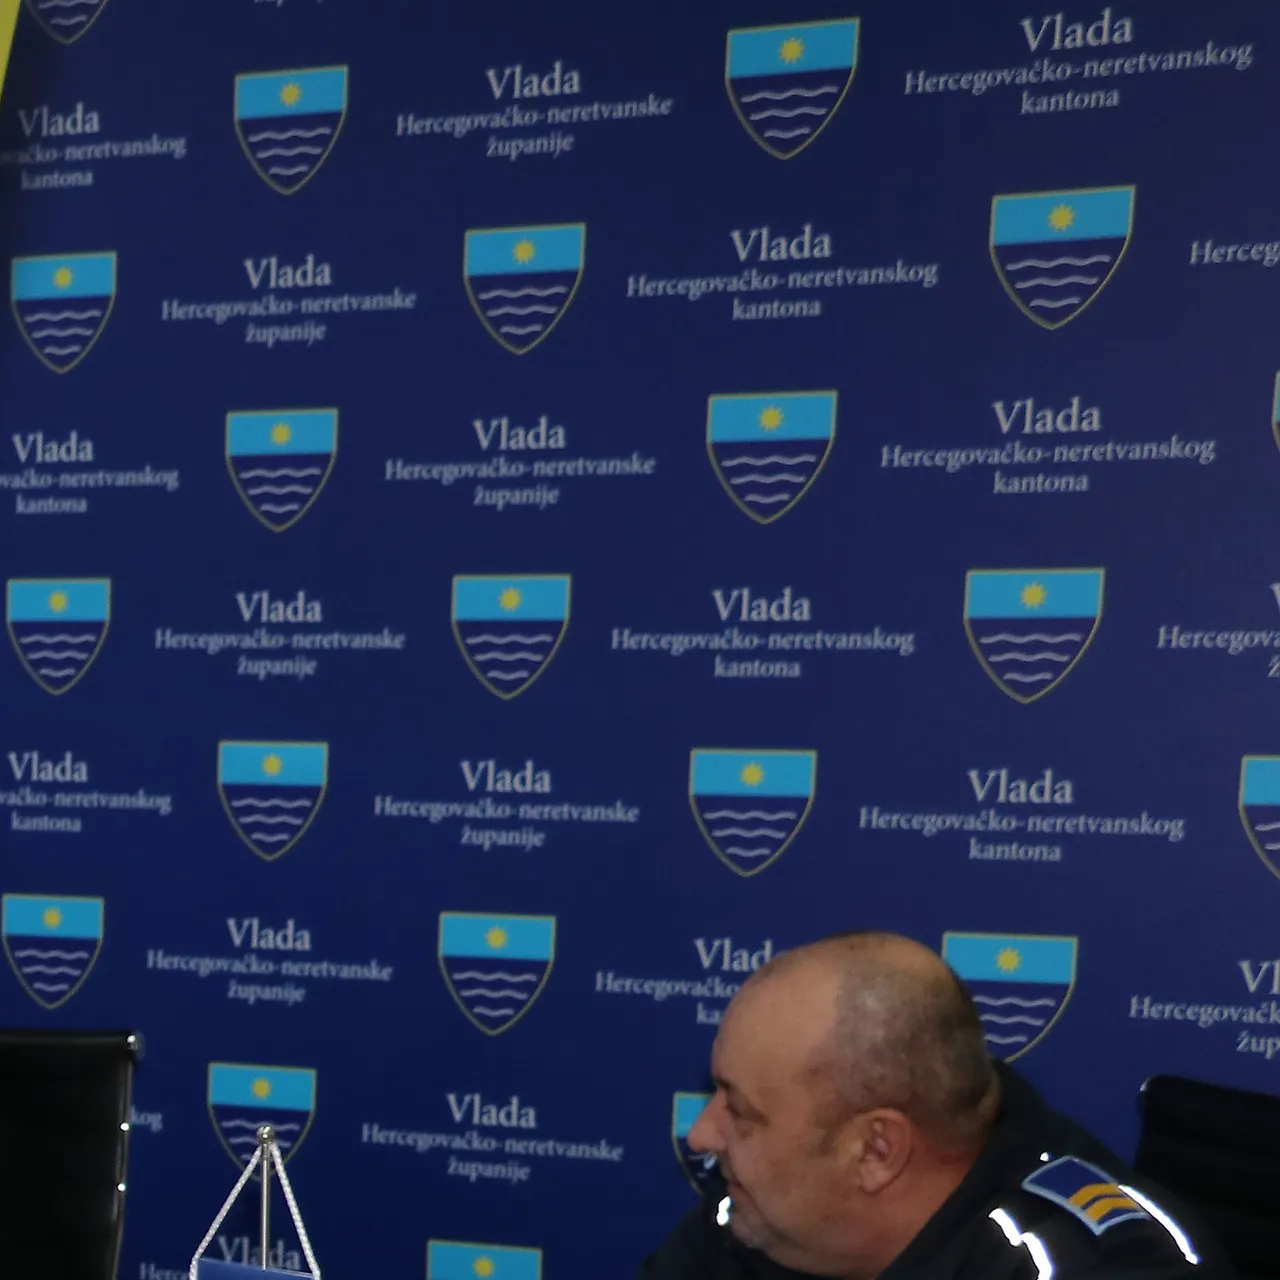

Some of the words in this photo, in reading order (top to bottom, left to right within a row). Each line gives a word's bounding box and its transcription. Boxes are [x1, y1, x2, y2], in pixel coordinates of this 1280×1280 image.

[1020, 6, 1133, 53] Vlada
[485, 60, 581, 100] Vlada
[904, 40, 1253, 96] Hercegovačko-neretvanskog
[395, 93, 673, 138] Hercegovačko-neretvanske
[1020, 88, 1120, 115] kantona
[17, 101, 100, 138] Vlada
[486, 131, 576, 162] županije
[21, 169, 94, 191] kantona
[730, 222, 832, 263] Vlada
[243, 253, 333, 290] Vlada
[626, 259, 939, 302] Hercegovačko-neretvanskog
[161, 286, 417, 325] Hercegovačko-neretvanske
[731, 297, 821, 321] kantona
[244, 321, 327, 349] županije
[472, 413, 567, 451] Vlada
[991, 395, 1101, 435] Vlada
[11, 429, 94, 464] Vlada
[880, 434, 1216, 474] Hercegovačko-neretvanskog
[383, 452, 656, 486] Hercegovačko-neretvanske
[992, 469, 1090, 495] kantona
[14, 493, 88, 515] kantona
[473, 484, 561, 511] županije
[235, 589, 323, 624] Vlada
[711, 585, 811, 622] Vlada
[154, 627, 406, 655] Hercegovačko-neretvanske
[610, 626, 915, 656] Hercegovačko-neretvanskog
[236, 655, 318, 681] županije
[713, 654, 801, 679] kantona
[7, 750, 89, 783] Vlada
[459, 758, 552, 794] Vlada
[966, 767, 1074, 805] Vlada
[10, 810, 83, 833] kantona
[373, 794, 640, 824] Hercegovačko-neretvanske
[858, 806, 1185, 843] Hercegovačko-neretvanskog
[460, 825, 546, 853] županije
[968, 836, 1062, 862] kantona
[226, 916, 312, 952] Vlada
[146, 949, 393, 982] Hercegovačko-neretvanske
[693, 936, 774, 972] Vlad
[227, 979, 306, 1006] županije
[446, 1092, 538, 1130] Vlada
[360, 1123, 624, 1163] Hercegovačko-neretvanske
[447, 1156, 532, 1184] županije
